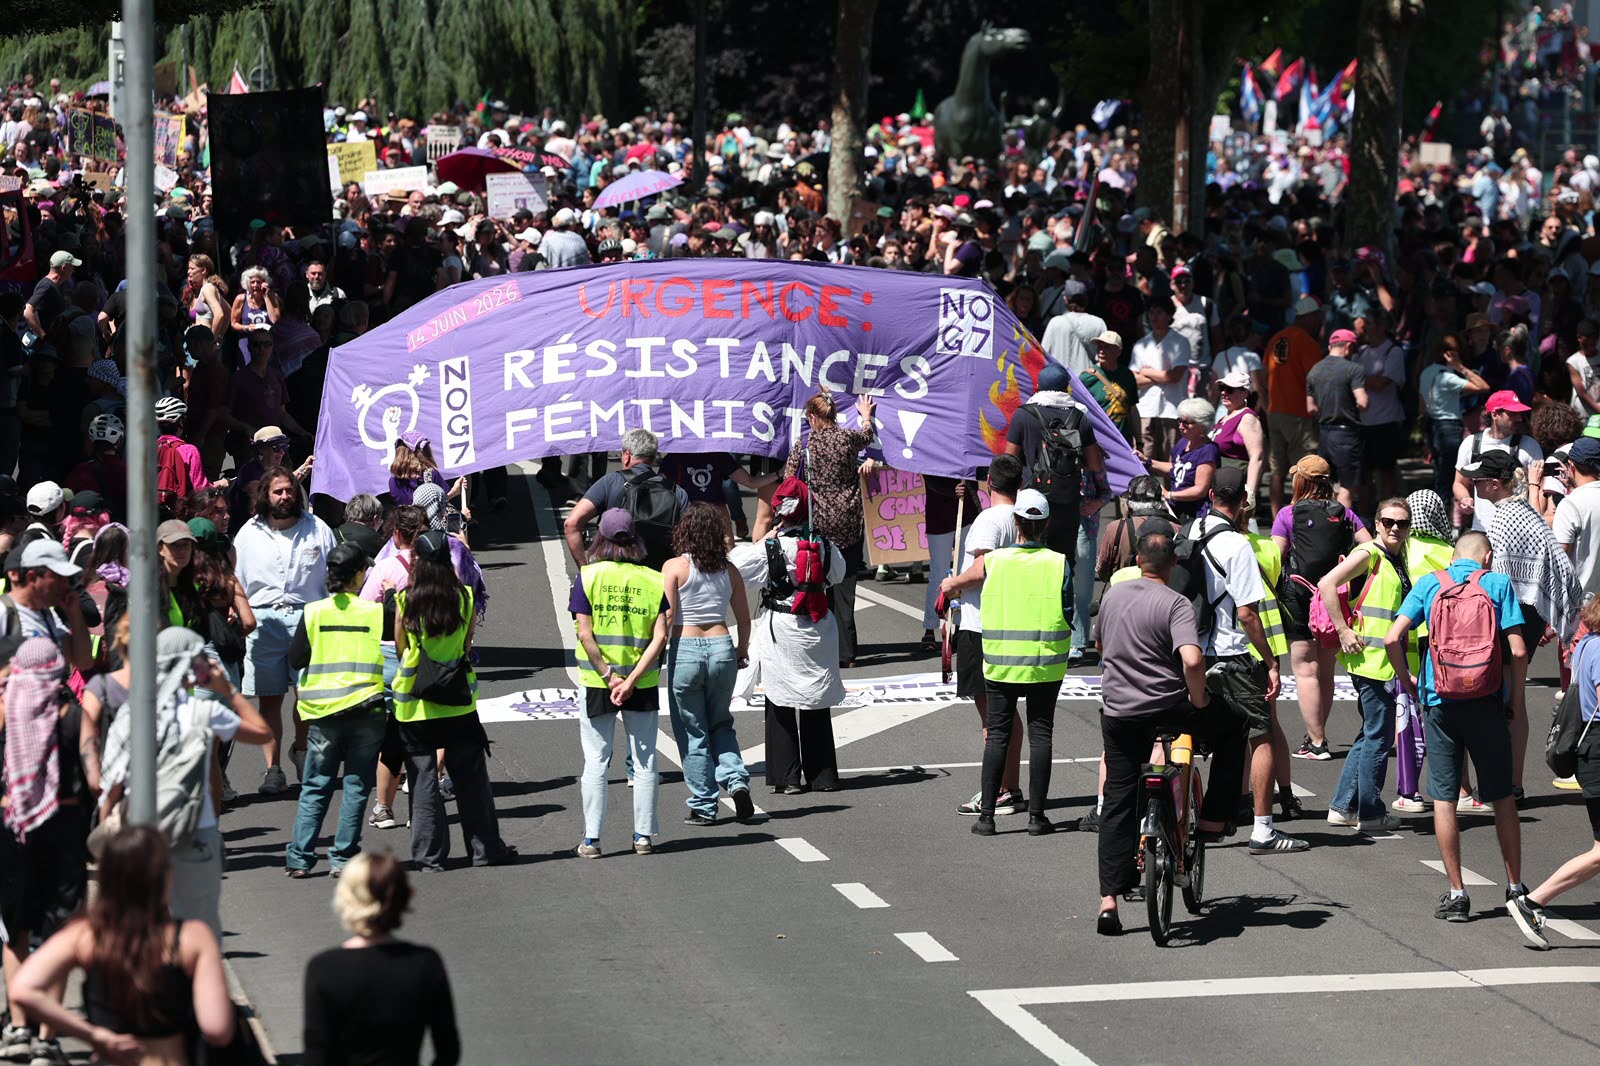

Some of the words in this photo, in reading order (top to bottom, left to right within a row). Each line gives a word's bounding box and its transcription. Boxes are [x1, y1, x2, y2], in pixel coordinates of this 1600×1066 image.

[71, 112, 90, 131] G7
[409, 329, 425, 350] 14
[431, 306, 468, 337] JUIN
[474, 283, 518, 316] 2026
[942, 292, 991, 322] NO
[941, 324, 991, 354] G7
[503, 332, 932, 400] RÉSISTANCES
[872, 524, 907, 551] JE
[608, 595, 634, 604] POSTE
